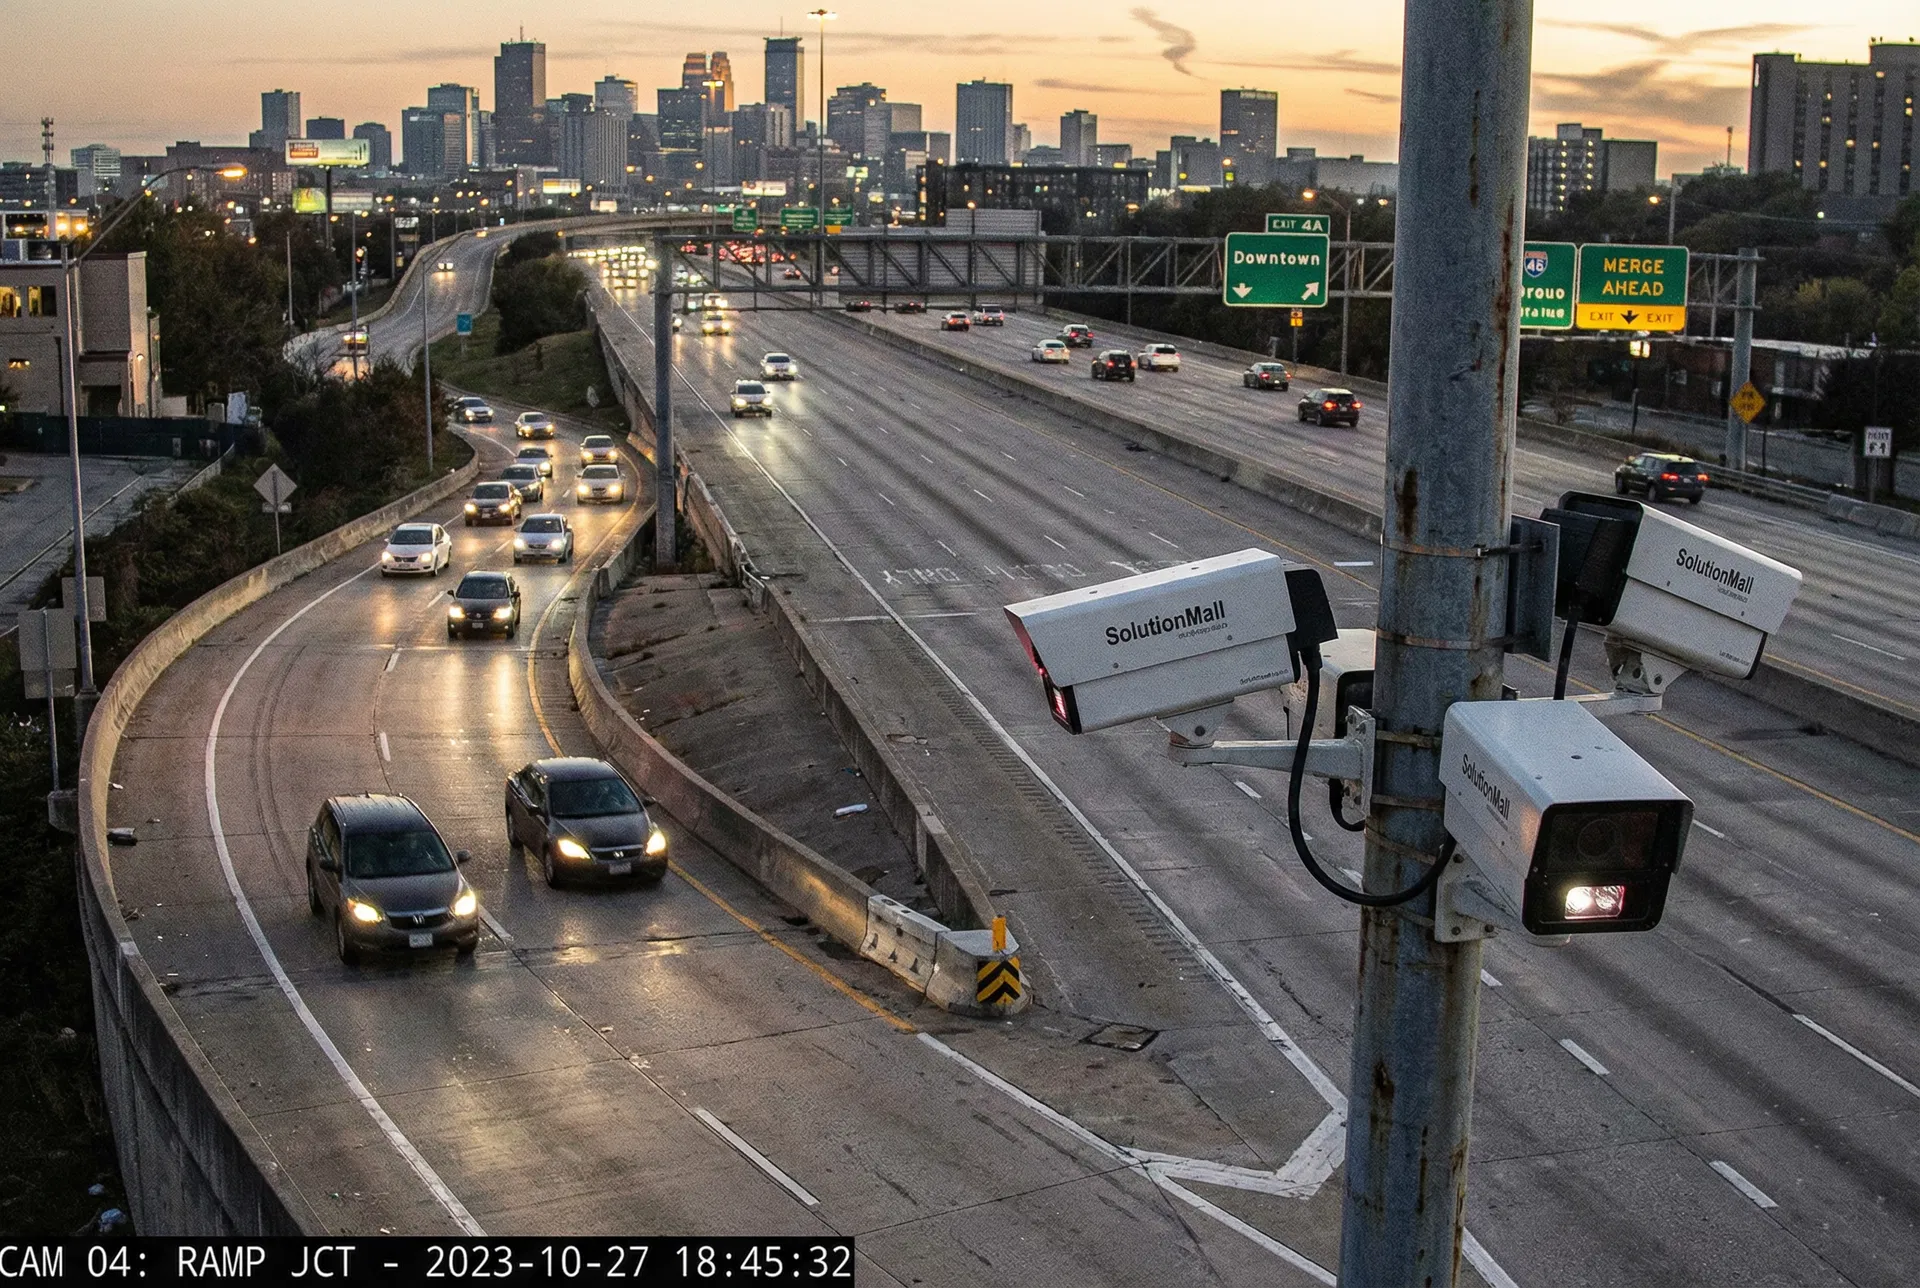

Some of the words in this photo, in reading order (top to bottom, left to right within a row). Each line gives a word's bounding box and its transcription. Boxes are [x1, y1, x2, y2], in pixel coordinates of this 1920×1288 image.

[1272, 219, 1297, 230] EXIT
[1301, 219, 1324, 232] 4A
[1233, 250, 1320, 266] Downtown
[1603, 257, 1665, 275] MERGE
[1602, 280, 1665, 297] AHEAD
[1589, 311, 1615, 322] EXIT
[1646, 312, 1674, 324] EXIT
[1675, 547, 1755, 595] SolutionMall
[1105, 600, 1226, 646] SolutionMall
[1462, 753, 1511, 821] SolutionMall
